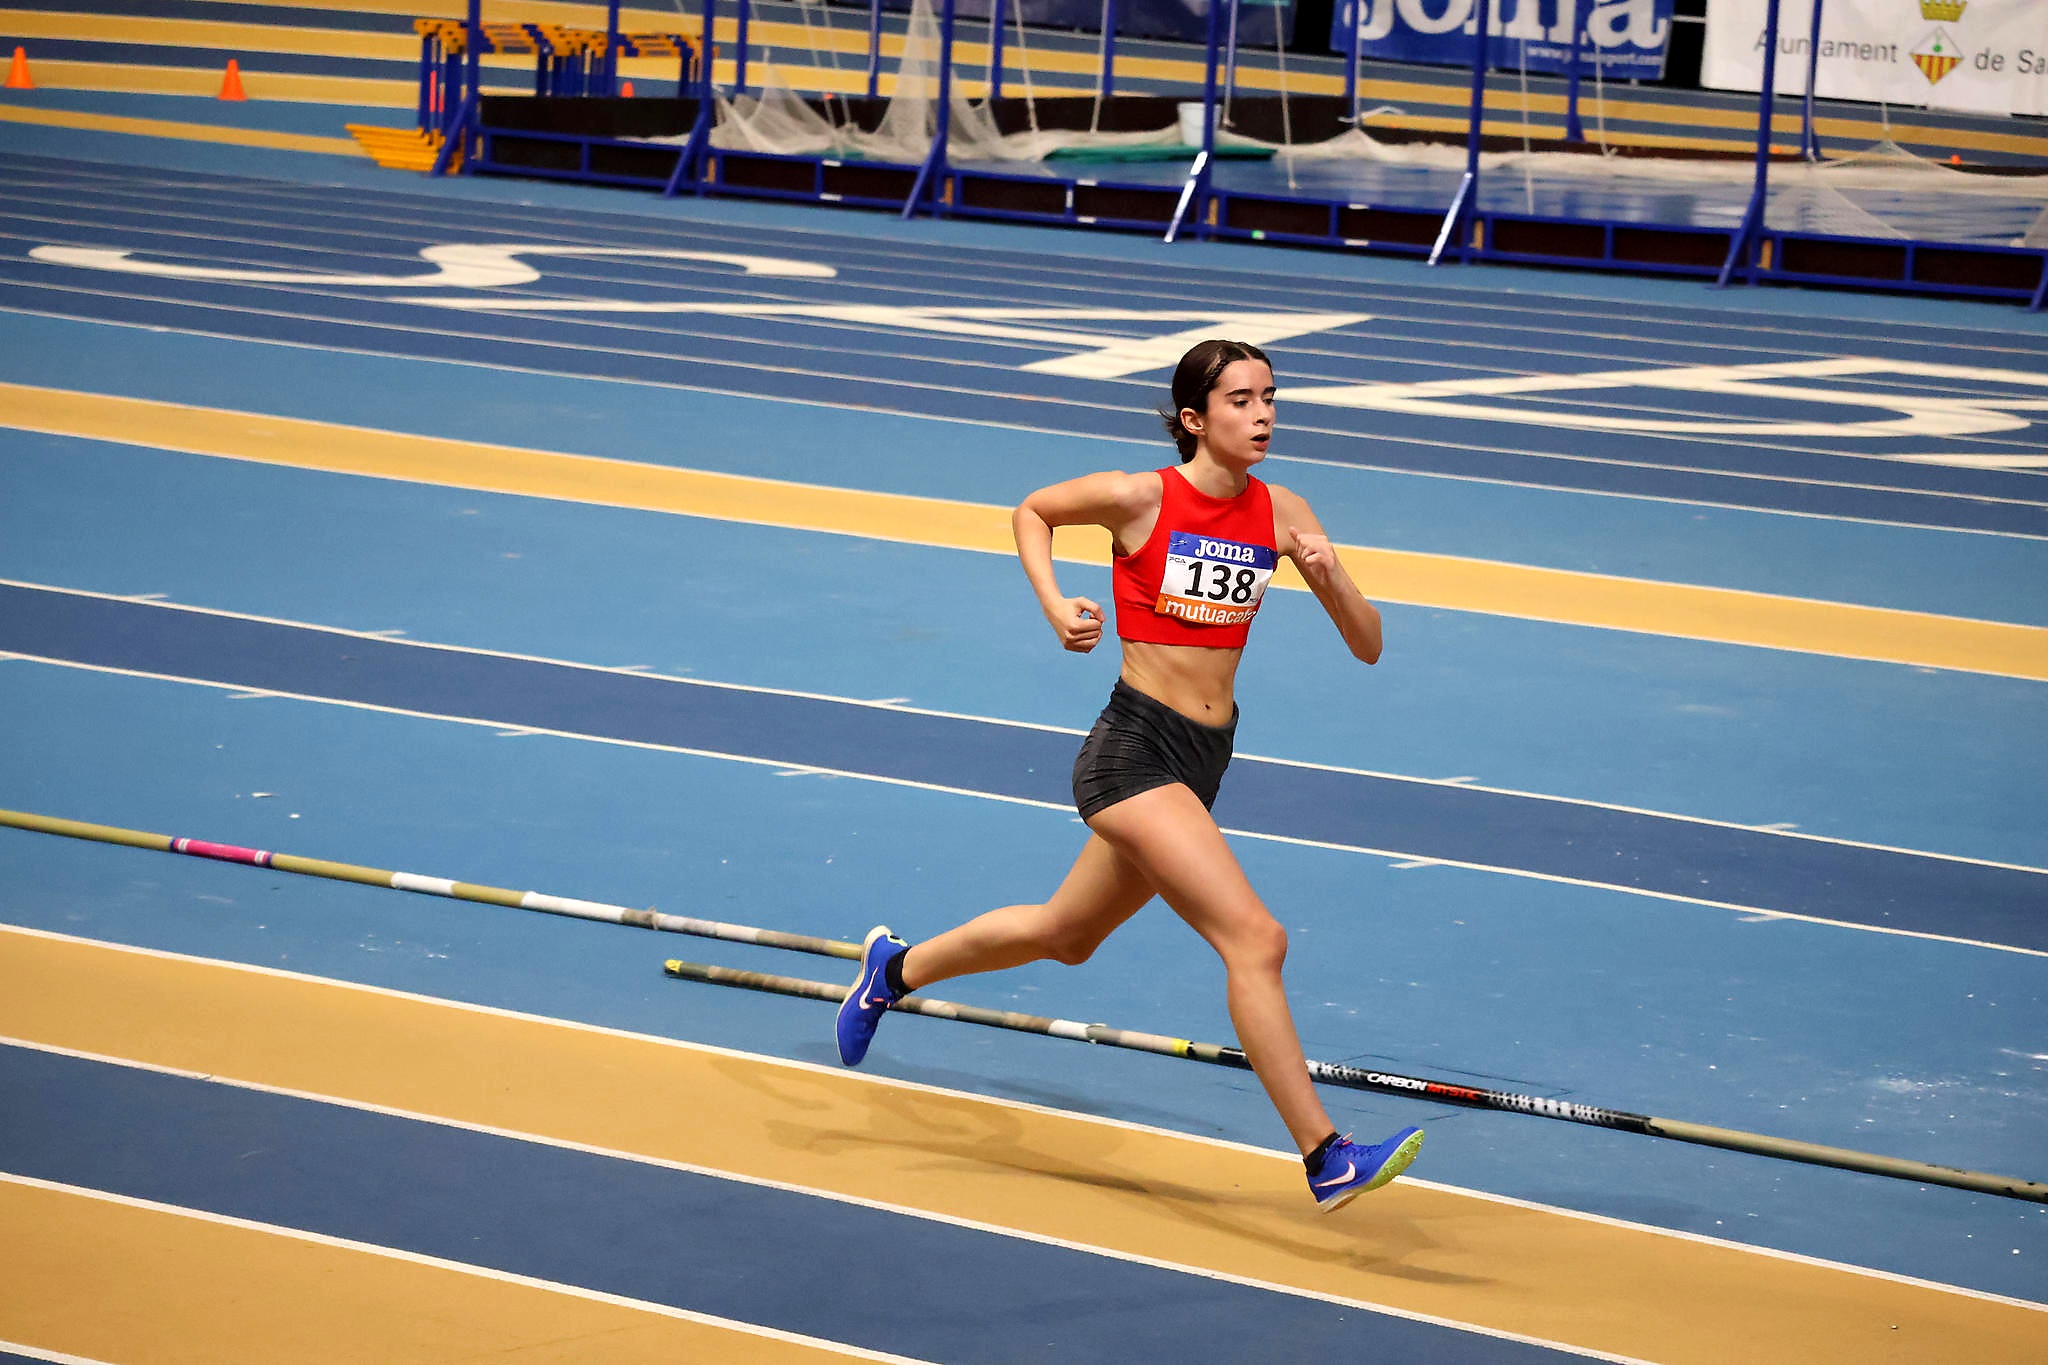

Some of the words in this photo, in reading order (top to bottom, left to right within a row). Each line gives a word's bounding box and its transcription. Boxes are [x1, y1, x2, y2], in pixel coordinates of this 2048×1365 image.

[1754, 30, 1899, 64] Aunament
[1975, 46, 2005, 72] de
[2017, 49, 2048, 75] Sa
[1185, 562, 1256, 603] 138
[1367, 1073, 1427, 1090] CARBON
